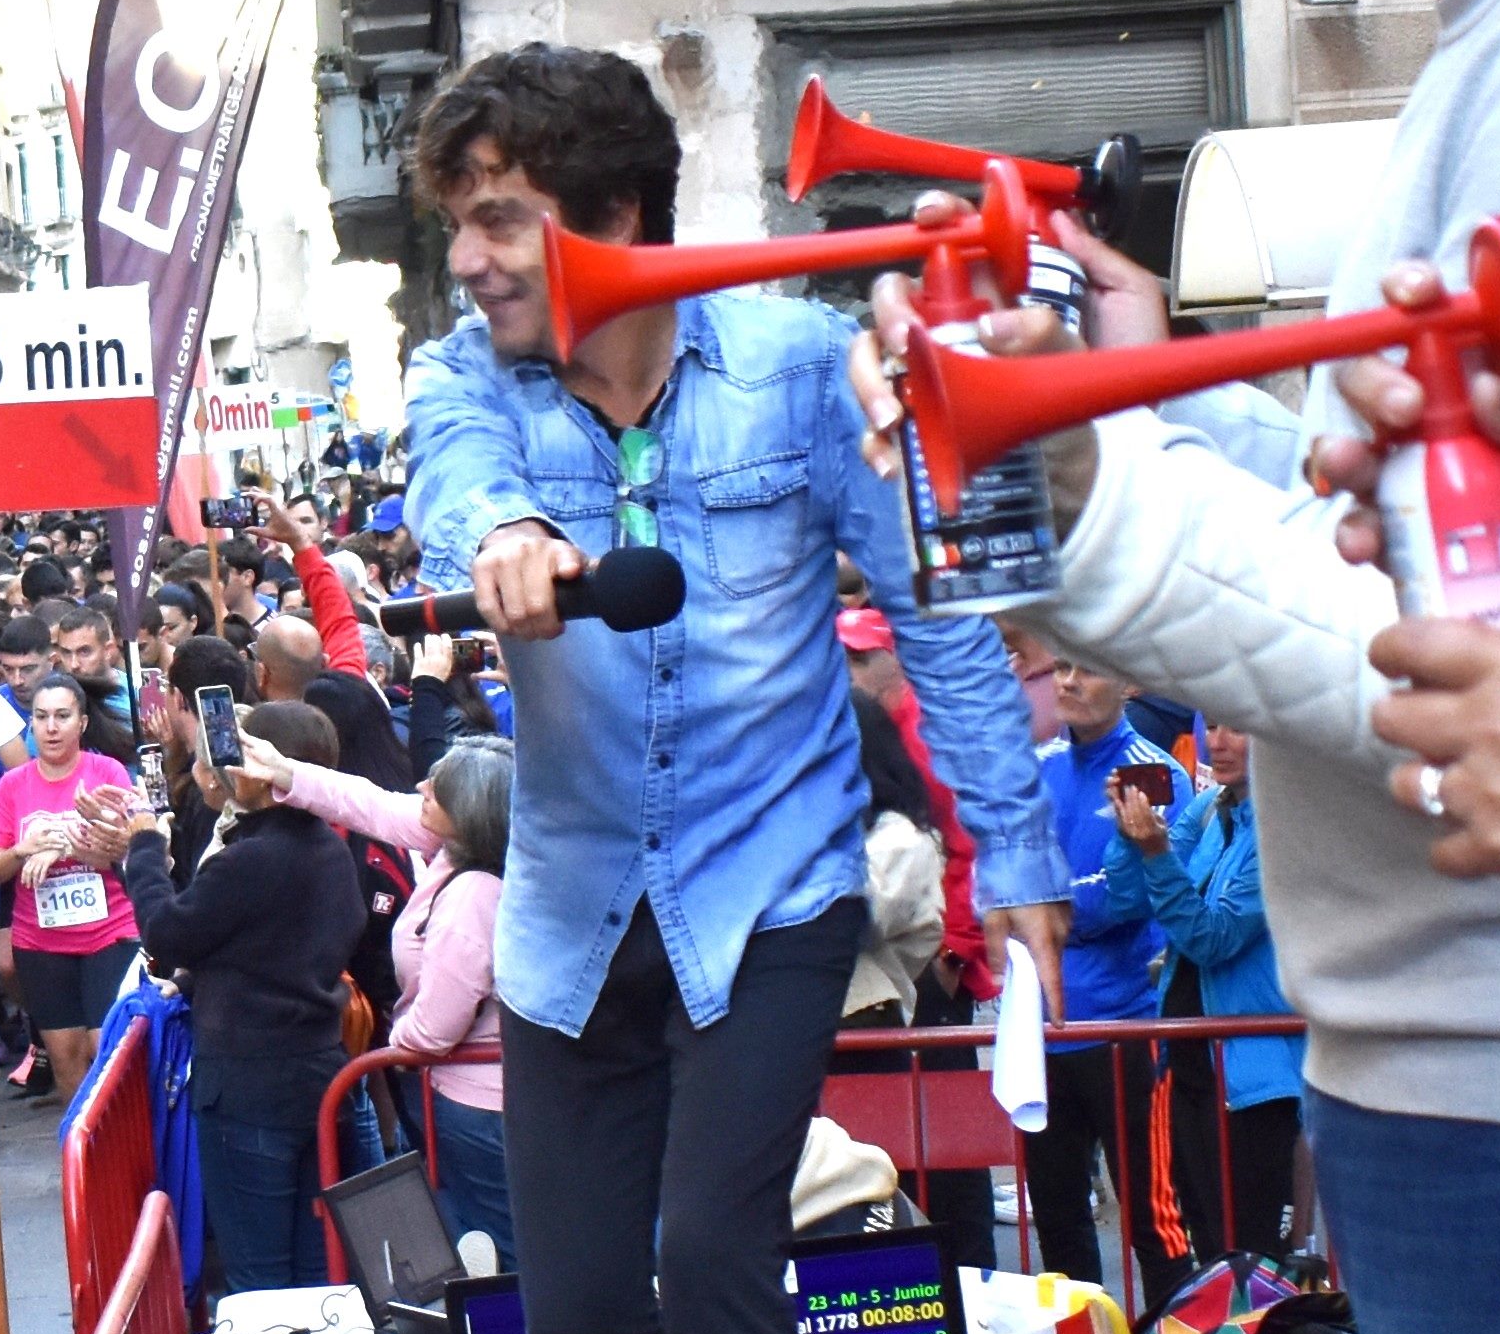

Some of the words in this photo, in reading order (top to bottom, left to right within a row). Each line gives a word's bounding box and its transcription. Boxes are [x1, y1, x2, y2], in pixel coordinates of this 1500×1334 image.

[25, 323, 143, 391] min.
[48, 887, 97, 911] 1168
[809, 1296, 828, 1311] 23
[840, 1292, 858, 1308] M
[870, 1289, 881, 1304] 5
[893, 1283, 941, 1301] Junior
[816, 1312, 859, 1333] 1778
[862, 1301, 944, 1327] 00:08:00
